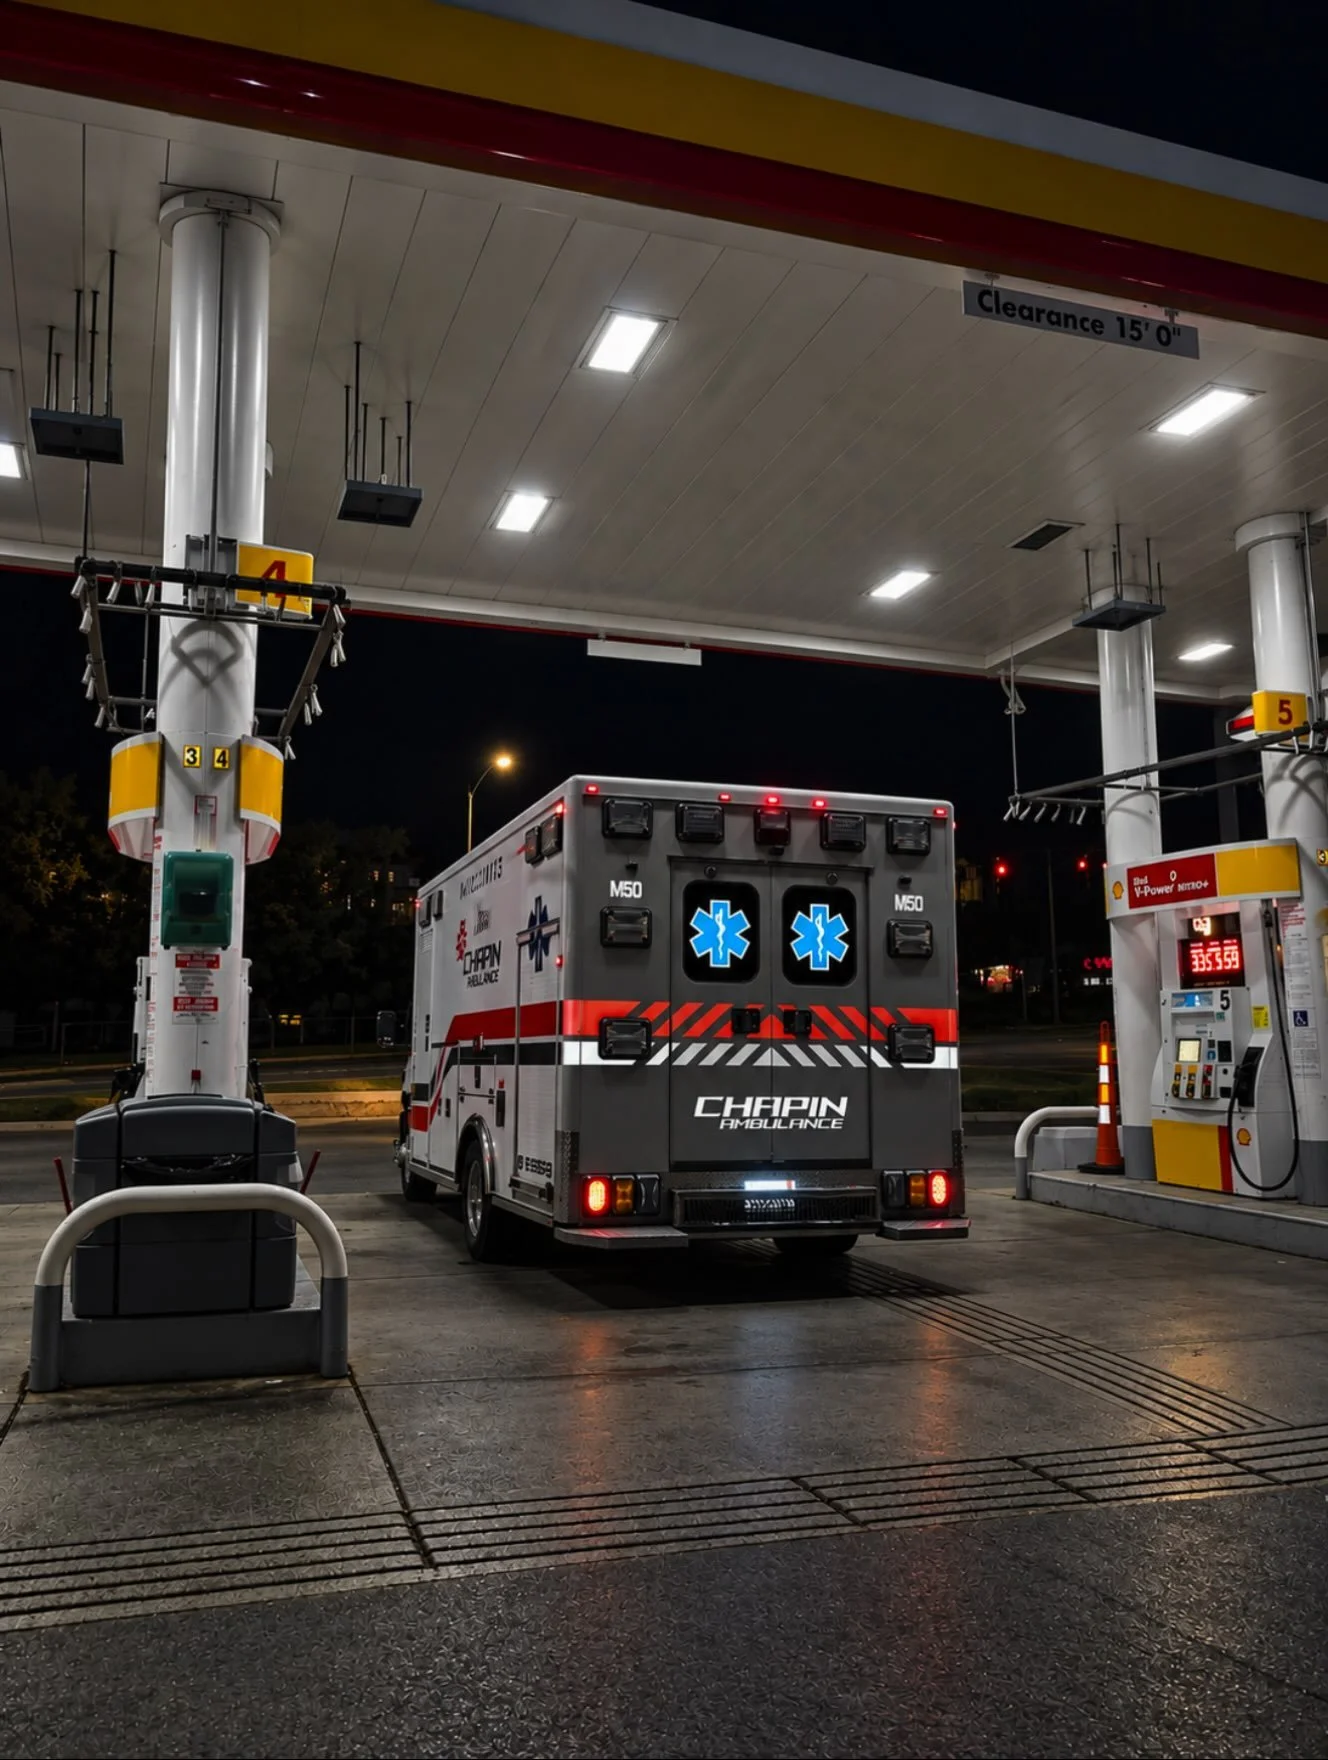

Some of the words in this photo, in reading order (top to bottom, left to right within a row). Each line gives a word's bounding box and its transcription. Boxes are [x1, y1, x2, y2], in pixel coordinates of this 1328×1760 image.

[977, 289, 1105, 336] Clearance
[1116, 316, 1149, 342] 15'
[261, 560, 287, 598] 4
[1278, 699, 1293, 725] 5
[185, 748, 198, 765] 3
[216, 750, 228, 767] 4
[610, 880, 642, 898] M50
[894, 894, 924, 912] M50
[463, 940, 501, 976] CHAPIN
[1220, 989, 1231, 1011] 5
[694, 1096, 848, 1118] CHAPIN
[719, 1118, 844, 1130] AMBULANCE
